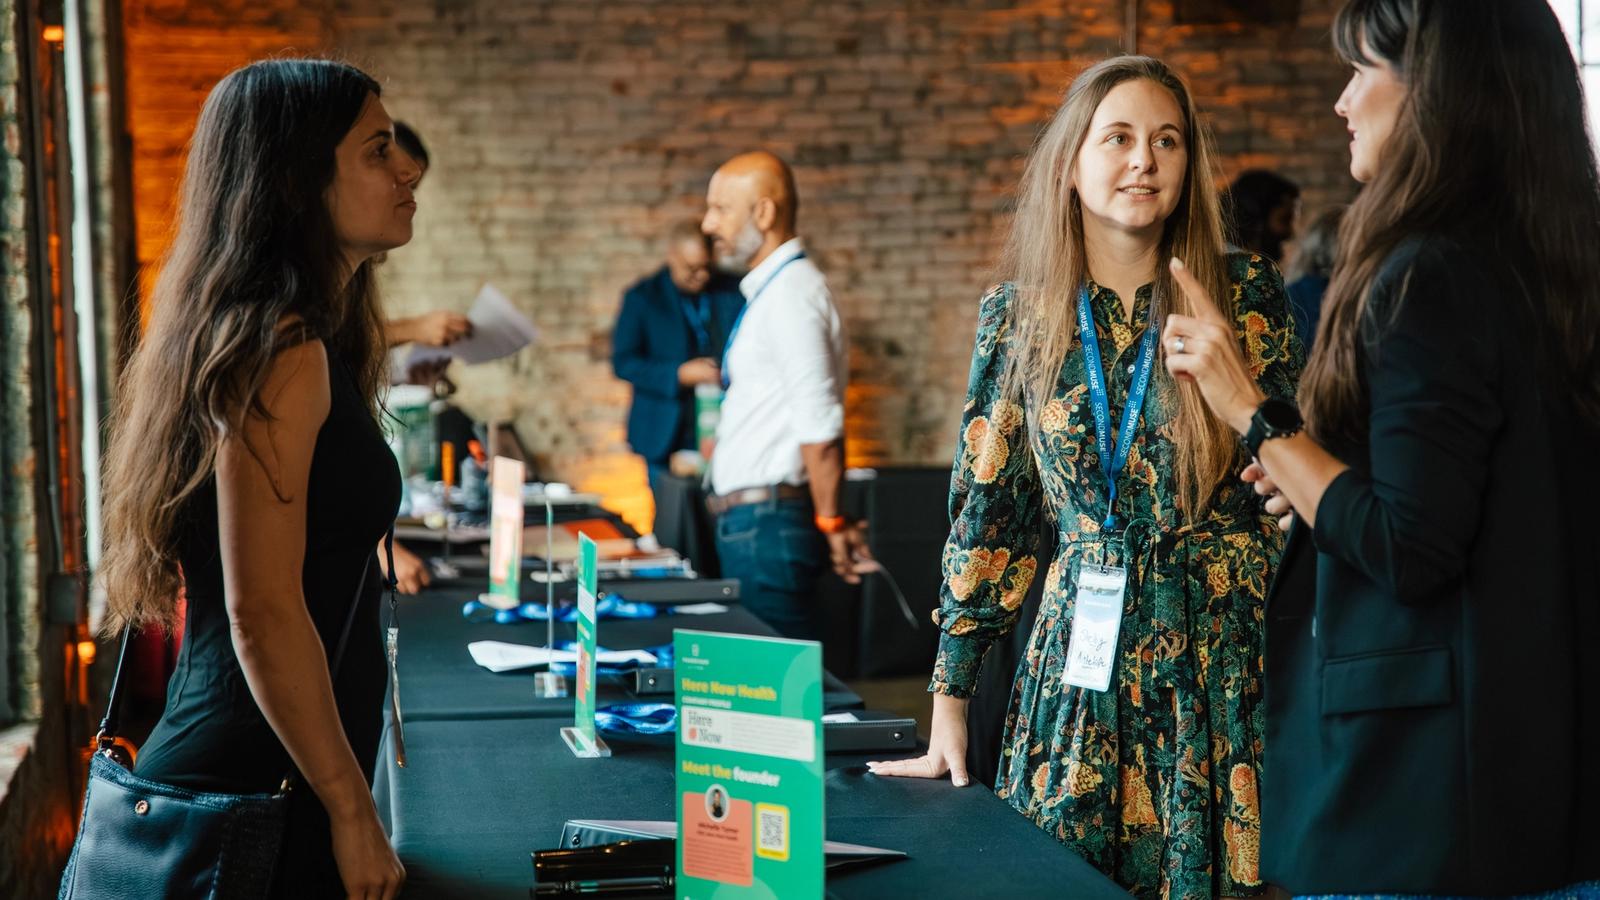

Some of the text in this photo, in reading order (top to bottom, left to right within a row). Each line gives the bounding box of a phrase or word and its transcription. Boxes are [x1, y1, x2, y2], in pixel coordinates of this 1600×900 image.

[1085, 344, 1099, 390] SECONDMUSE
[1136, 347, 1153, 395] SECONDMUSE
[1095, 402, 1107, 452] SECONDMUSE
[1120, 408, 1138, 457] SECONDMUSE
[682, 677, 777, 701] Here Now Health
[688, 711, 712, 727] Here
[700, 728, 722, 744] Now
[682, 760, 780, 788] Meet the founder
